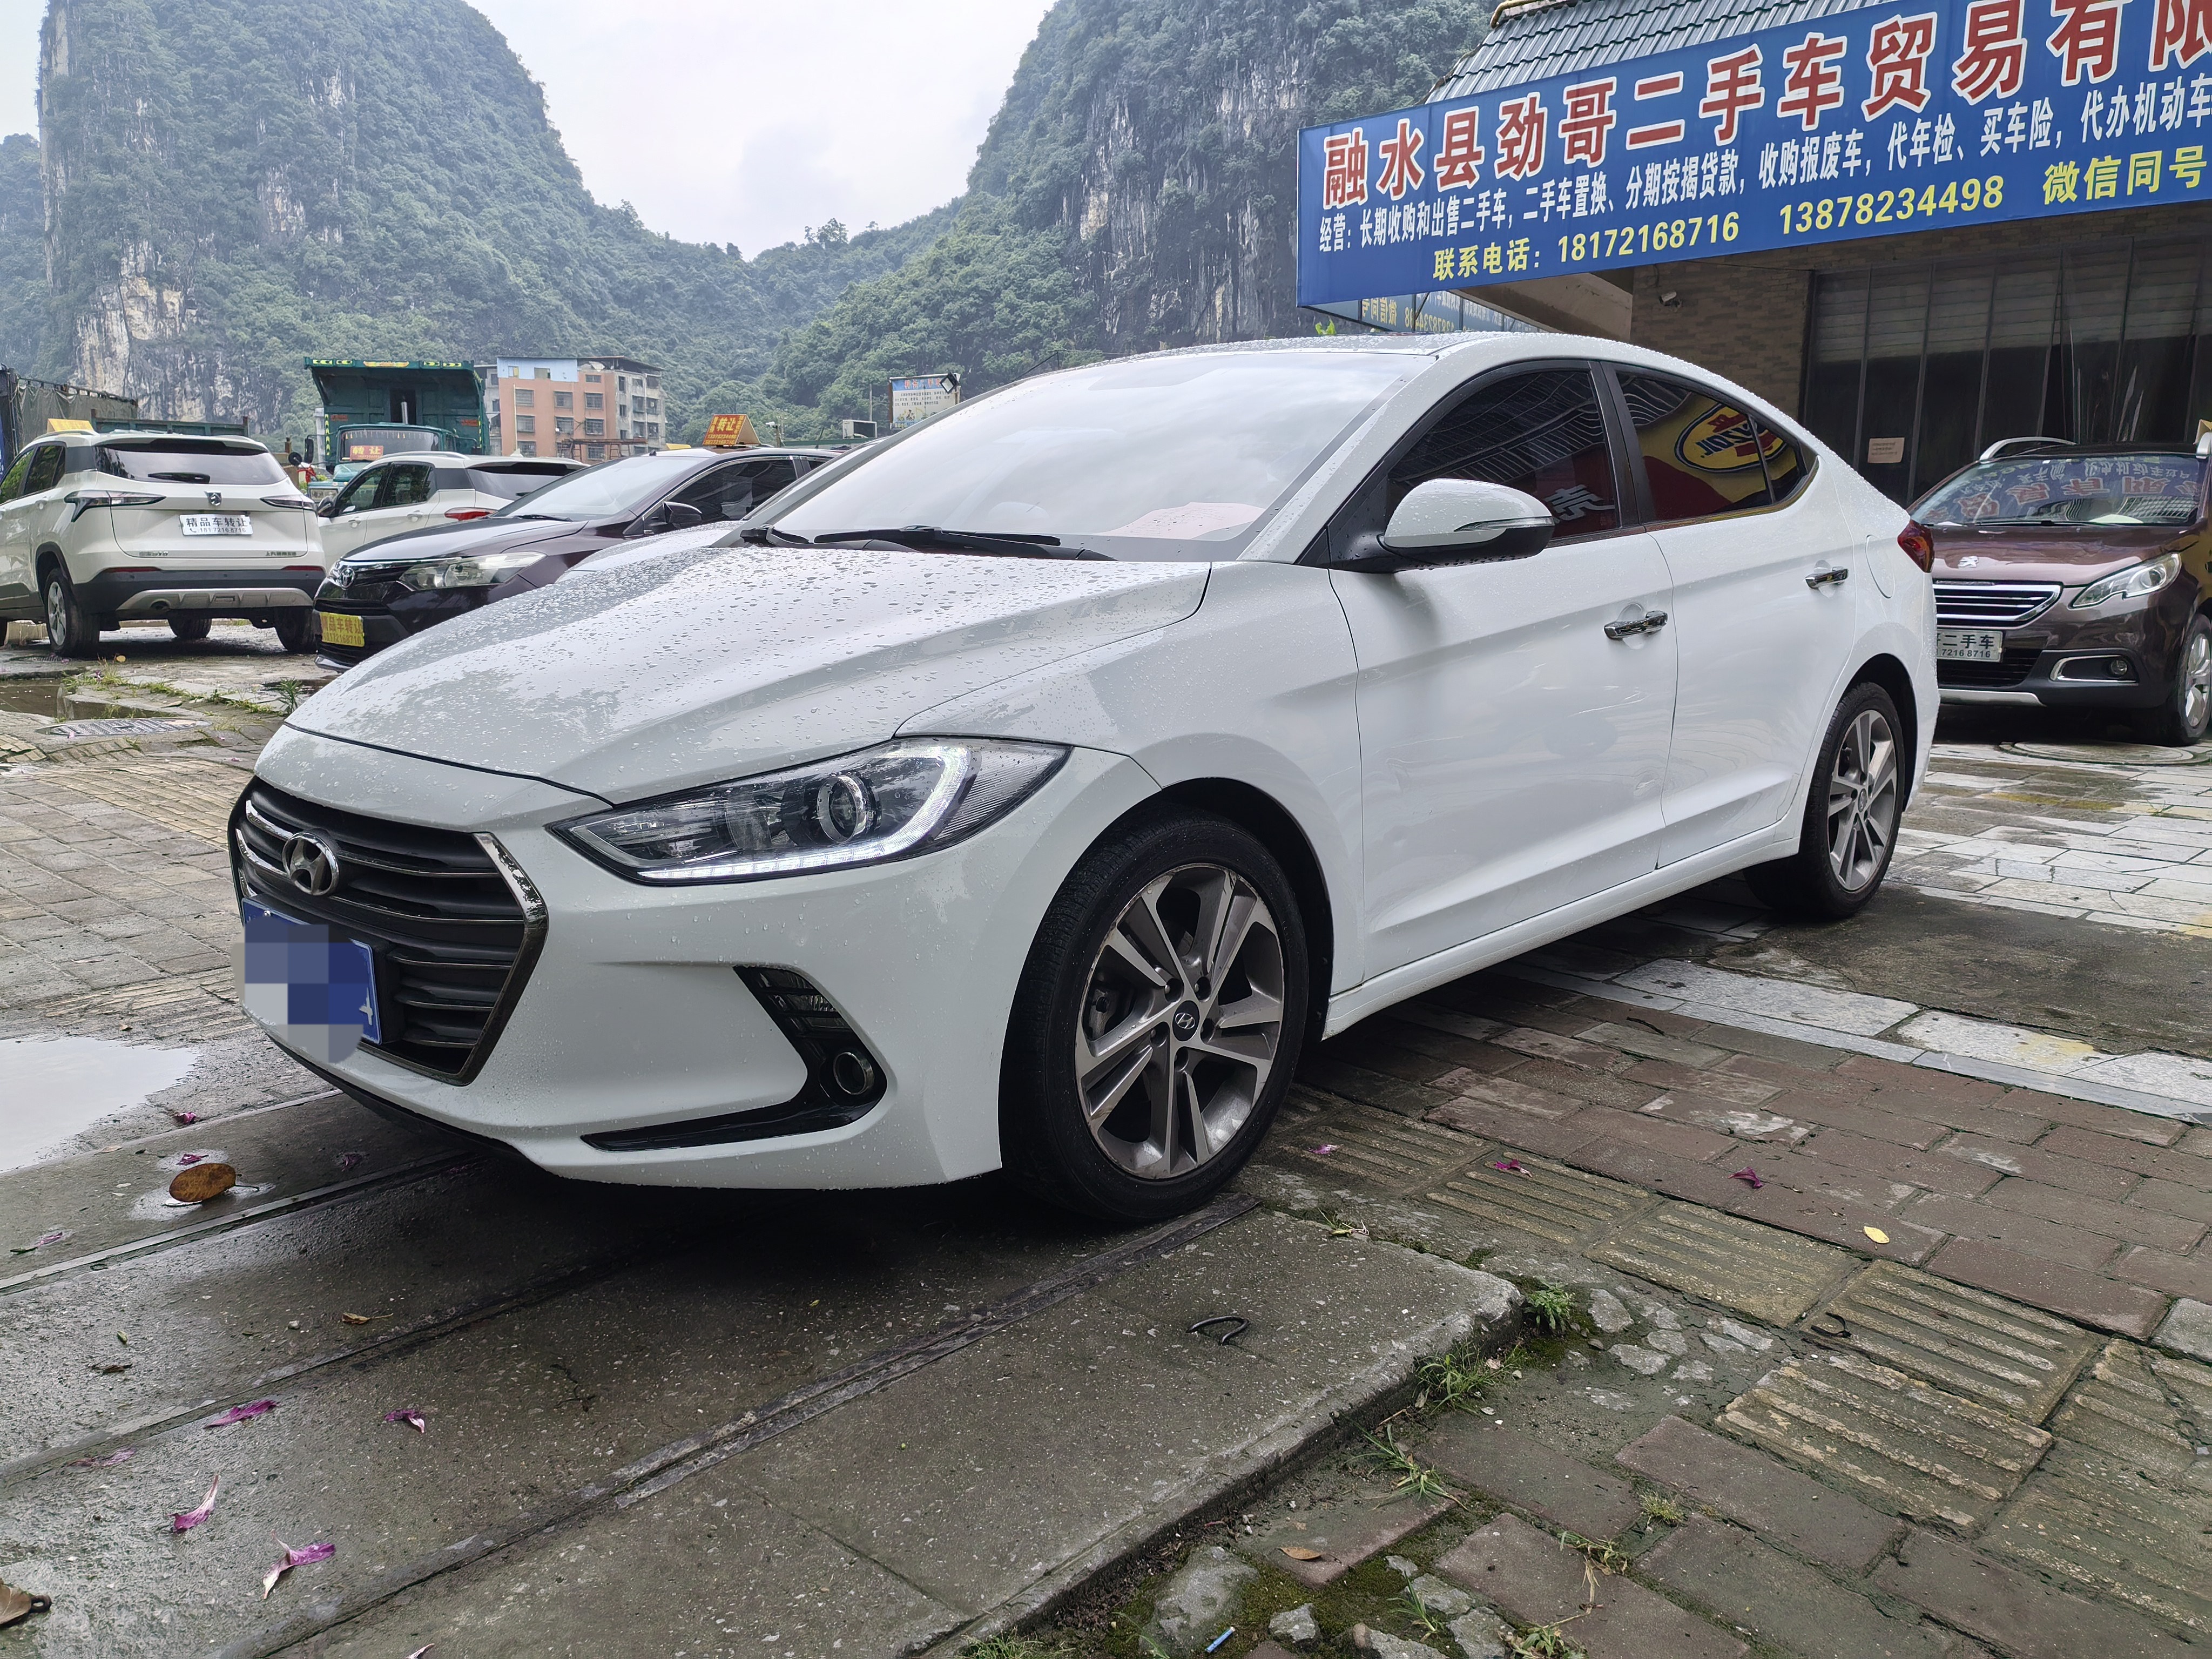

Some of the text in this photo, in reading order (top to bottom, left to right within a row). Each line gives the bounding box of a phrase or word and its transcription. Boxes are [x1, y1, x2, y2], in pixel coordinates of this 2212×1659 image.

[1780, 176, 2004, 235] 13878234498
[2043, 145, 2207, 205] 微信同号
[186, 517, 247, 527] 精品车转让
